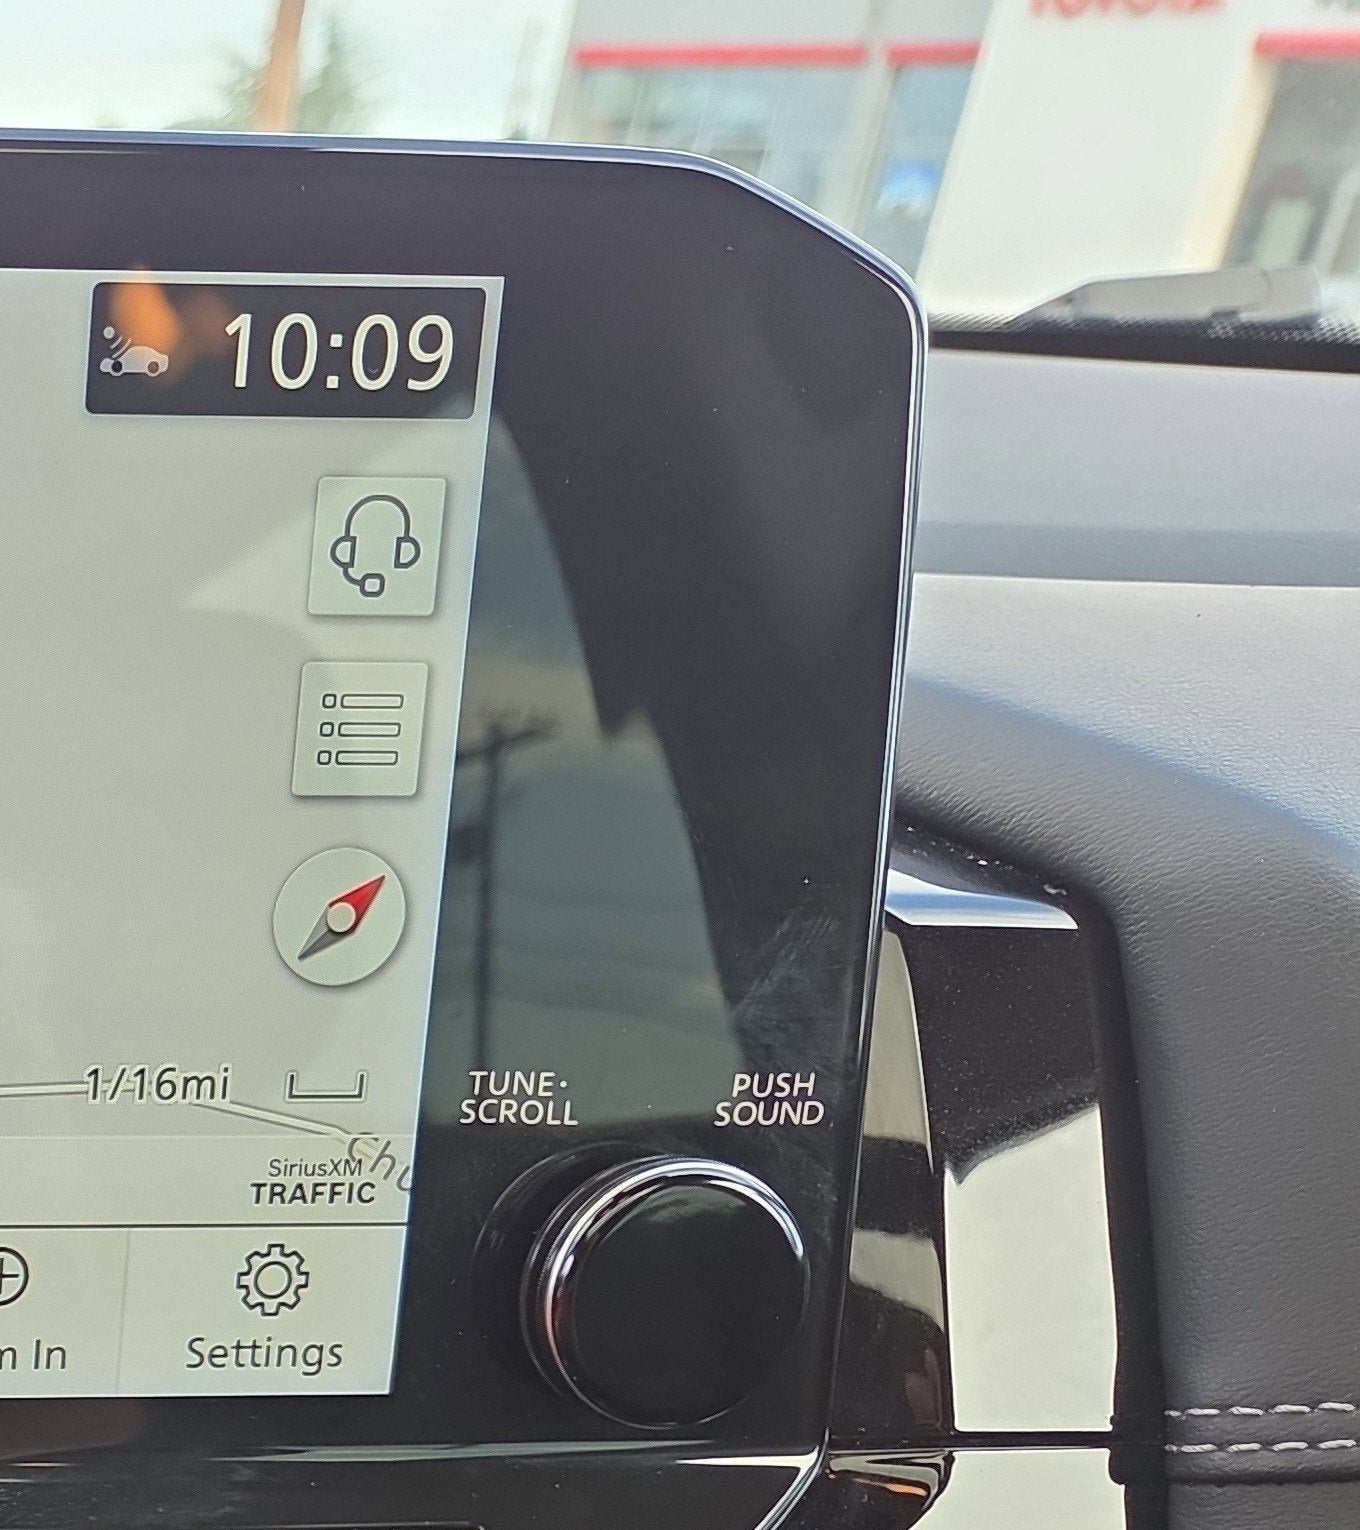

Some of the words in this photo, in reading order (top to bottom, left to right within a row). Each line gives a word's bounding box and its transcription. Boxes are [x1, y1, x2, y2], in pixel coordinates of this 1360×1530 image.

[225, 312, 454, 391] 10:09
[86, 1064, 230, 1102] 1/16mi
[731, 1072, 816, 1098] PUSH
[459, 1099, 579, 1127] SCROLL
[713, 1100, 825, 1128] SOUND
[267, 1157, 363, 1178] SiriusXM
[250, 1181, 376, 1205] TRAFFIC
[33, 1339, 68, 1371] In
[185, 1336, 344, 1376] Settings
